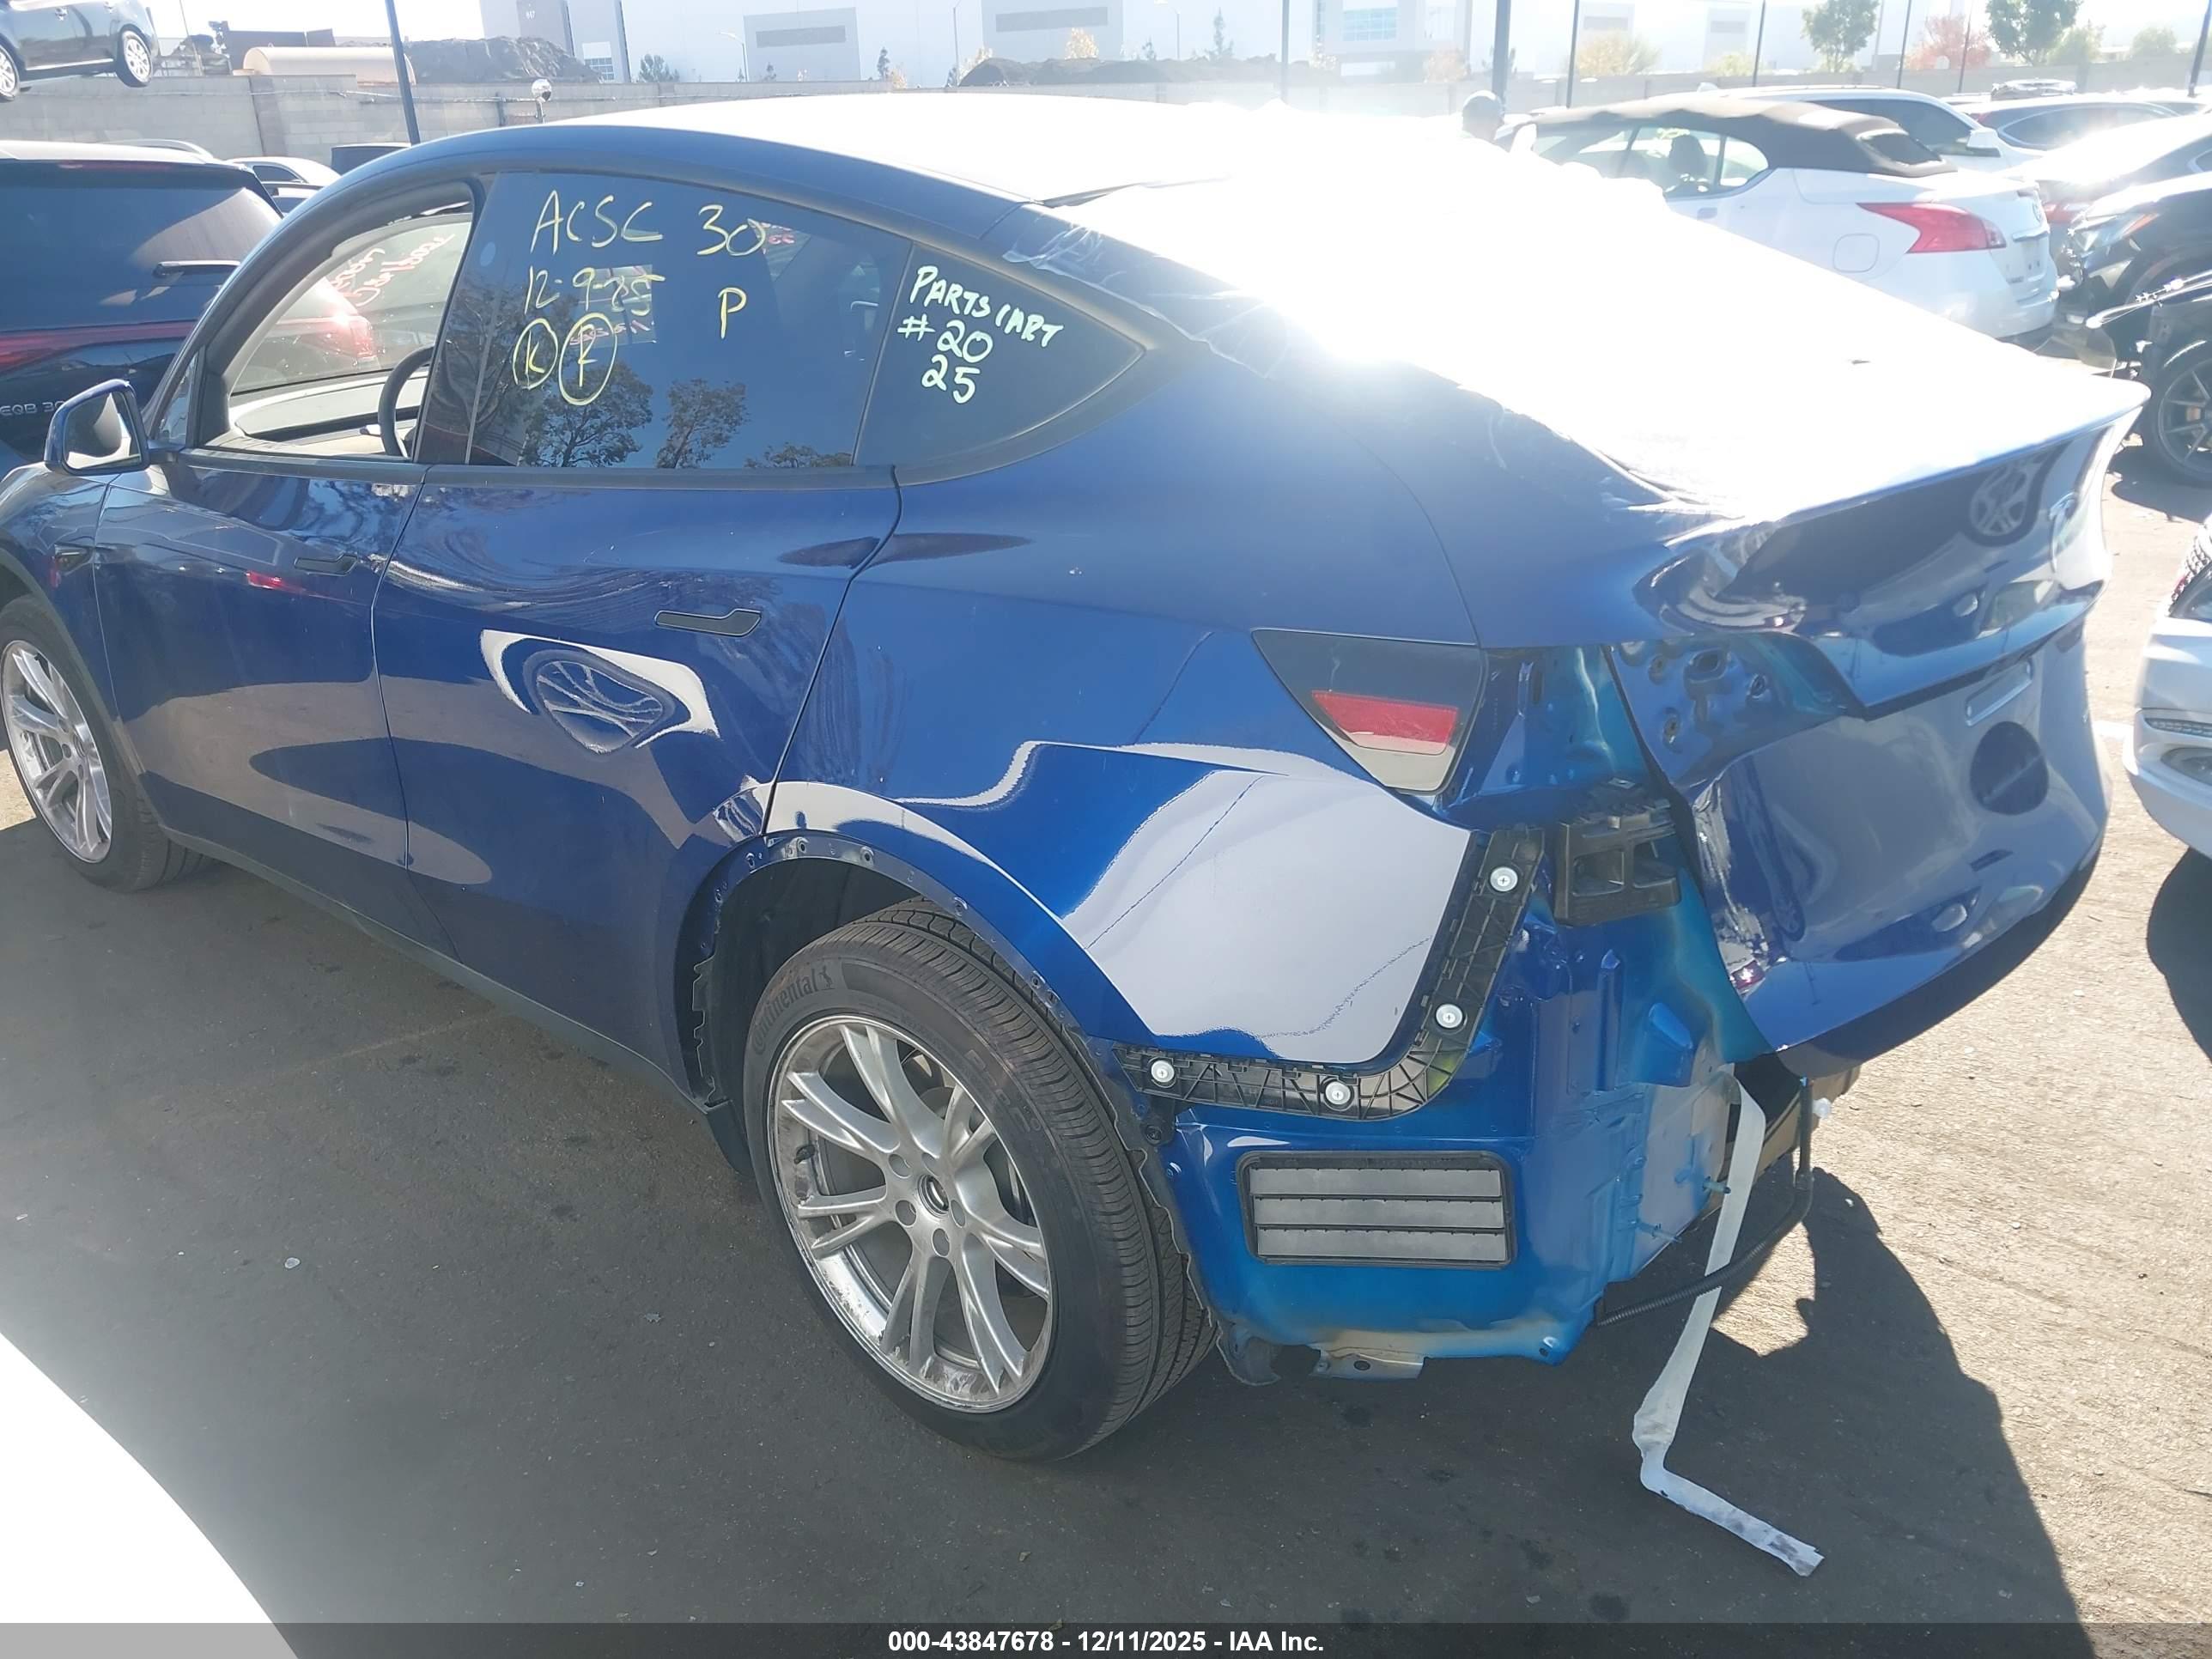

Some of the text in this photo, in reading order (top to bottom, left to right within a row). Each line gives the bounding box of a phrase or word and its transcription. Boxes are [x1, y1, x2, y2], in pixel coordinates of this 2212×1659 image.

[696, 204, 767, 257] 30
[718, 287, 747, 339] P
[909, 265, 992, 318] PARTS
[921, 355, 981, 404] 25
[0, 404, 37, 416] EQB
[753, 969, 819, 1054] Continental
